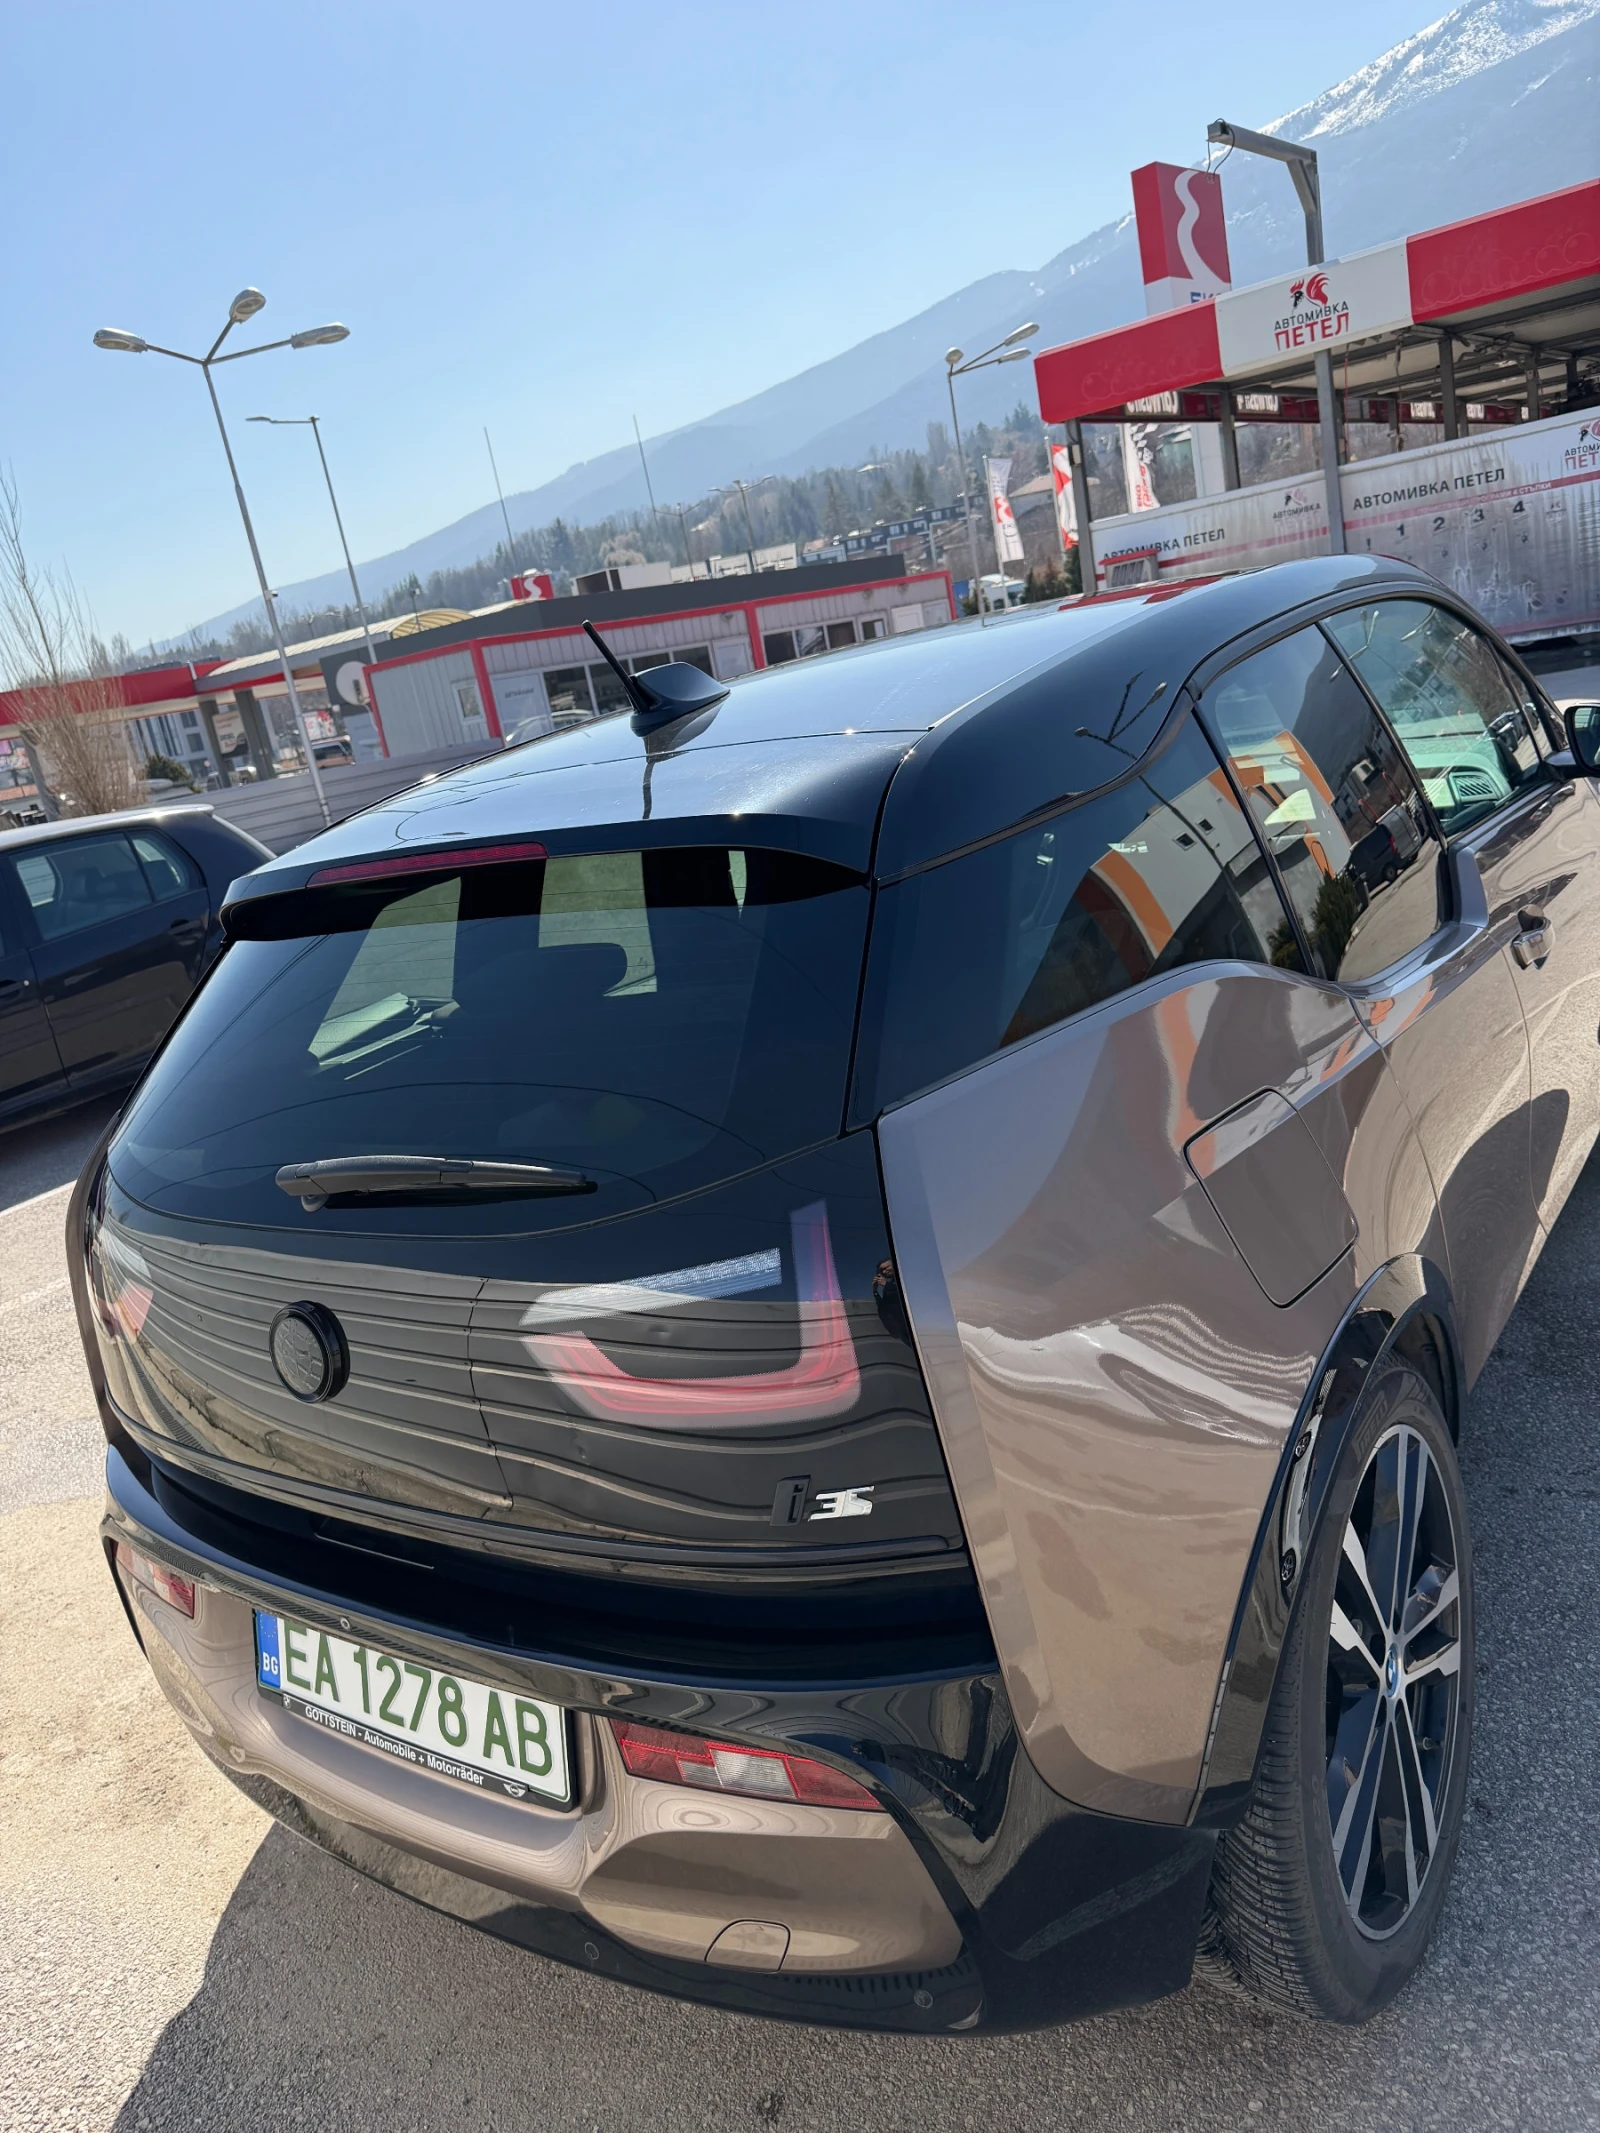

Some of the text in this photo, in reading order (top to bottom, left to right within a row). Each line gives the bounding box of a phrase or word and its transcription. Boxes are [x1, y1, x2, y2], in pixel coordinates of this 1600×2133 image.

[1274, 301, 1349, 331] АВТОМИВКА
[1274, 312, 1350, 351] ПЕТЕЛ
[1353, 480, 1450, 510] АВТОМИВКА
[1454, 468, 1505, 490] ПЕТЕЛ
[1512, 501, 1525, 513] 4
[1396, 524, 1405, 536] 1
[1433, 516, 1445, 531] 2
[1183, 529, 1225, 547] ПЕТЕЛ
[262, 1651, 280, 1676] BG
[283, 1620, 553, 1778] EA 1278 AB
[305, 1705, 357, 1738] GOTTSTEIN
[363, 1730, 417, 1763] Automobile
[426, 1755, 485, 1787] Motorräder
